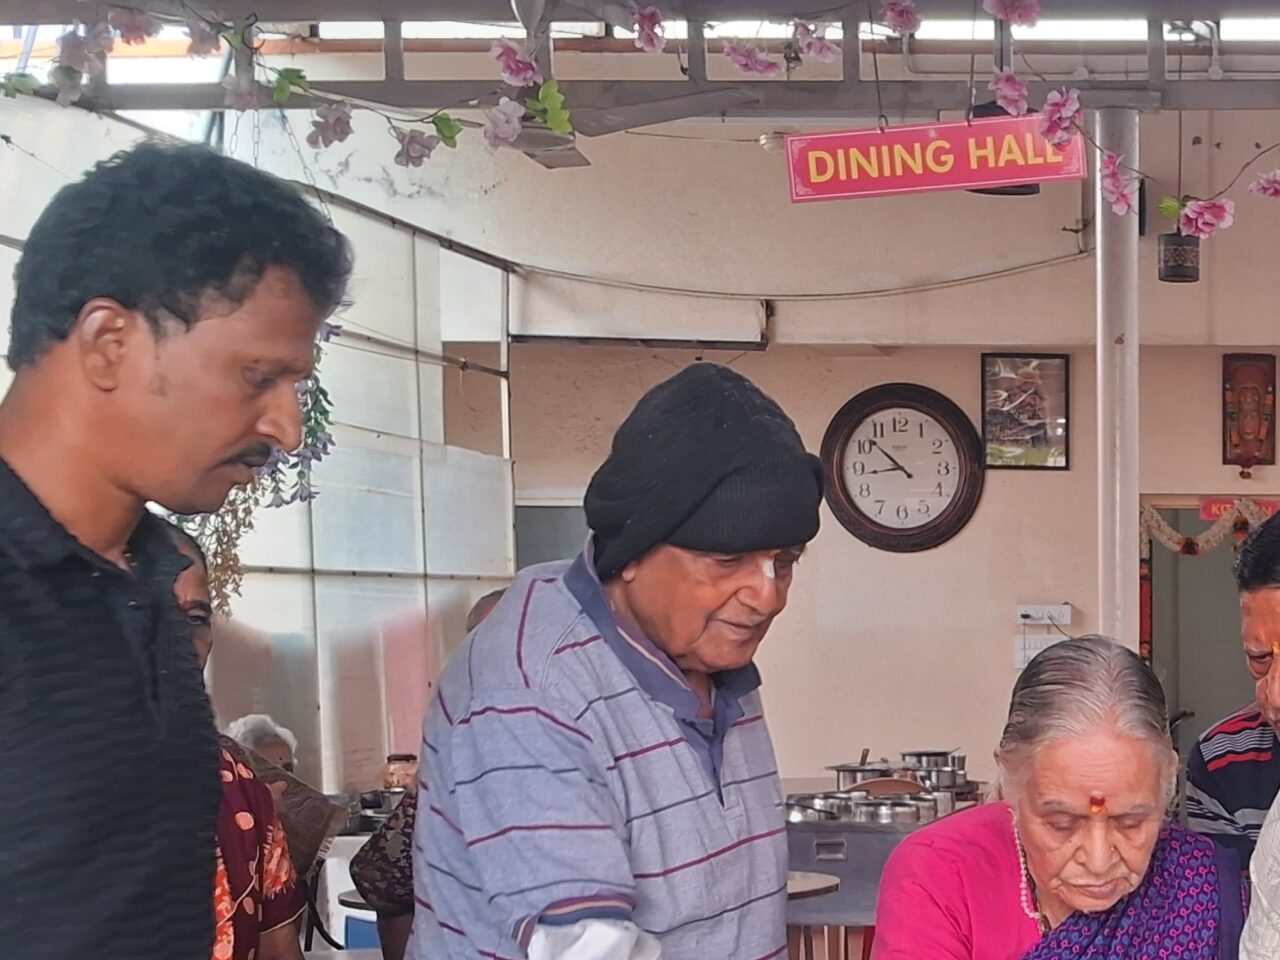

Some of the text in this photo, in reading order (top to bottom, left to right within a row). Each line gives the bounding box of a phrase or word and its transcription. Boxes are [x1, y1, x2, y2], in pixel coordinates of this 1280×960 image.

[807, 132, 1063, 183] DINING HALL
[872, 421, 885, 438] 11
[892, 416, 909, 433] 12
[918, 422, 925, 438] 1
[857, 439, 873, 455] 10
[932, 438, 943, 455] 2
[852, 461, 865, 476] 9
[937, 461, 950, 476] 3
[859, 482, 871, 497] 8
[934, 482, 943, 497] 4
[874, 499, 886, 515] 7
[896, 505, 909, 520] 6
[917, 499, 930, 514] 5
[1211, 503, 1272, 517] KITN
